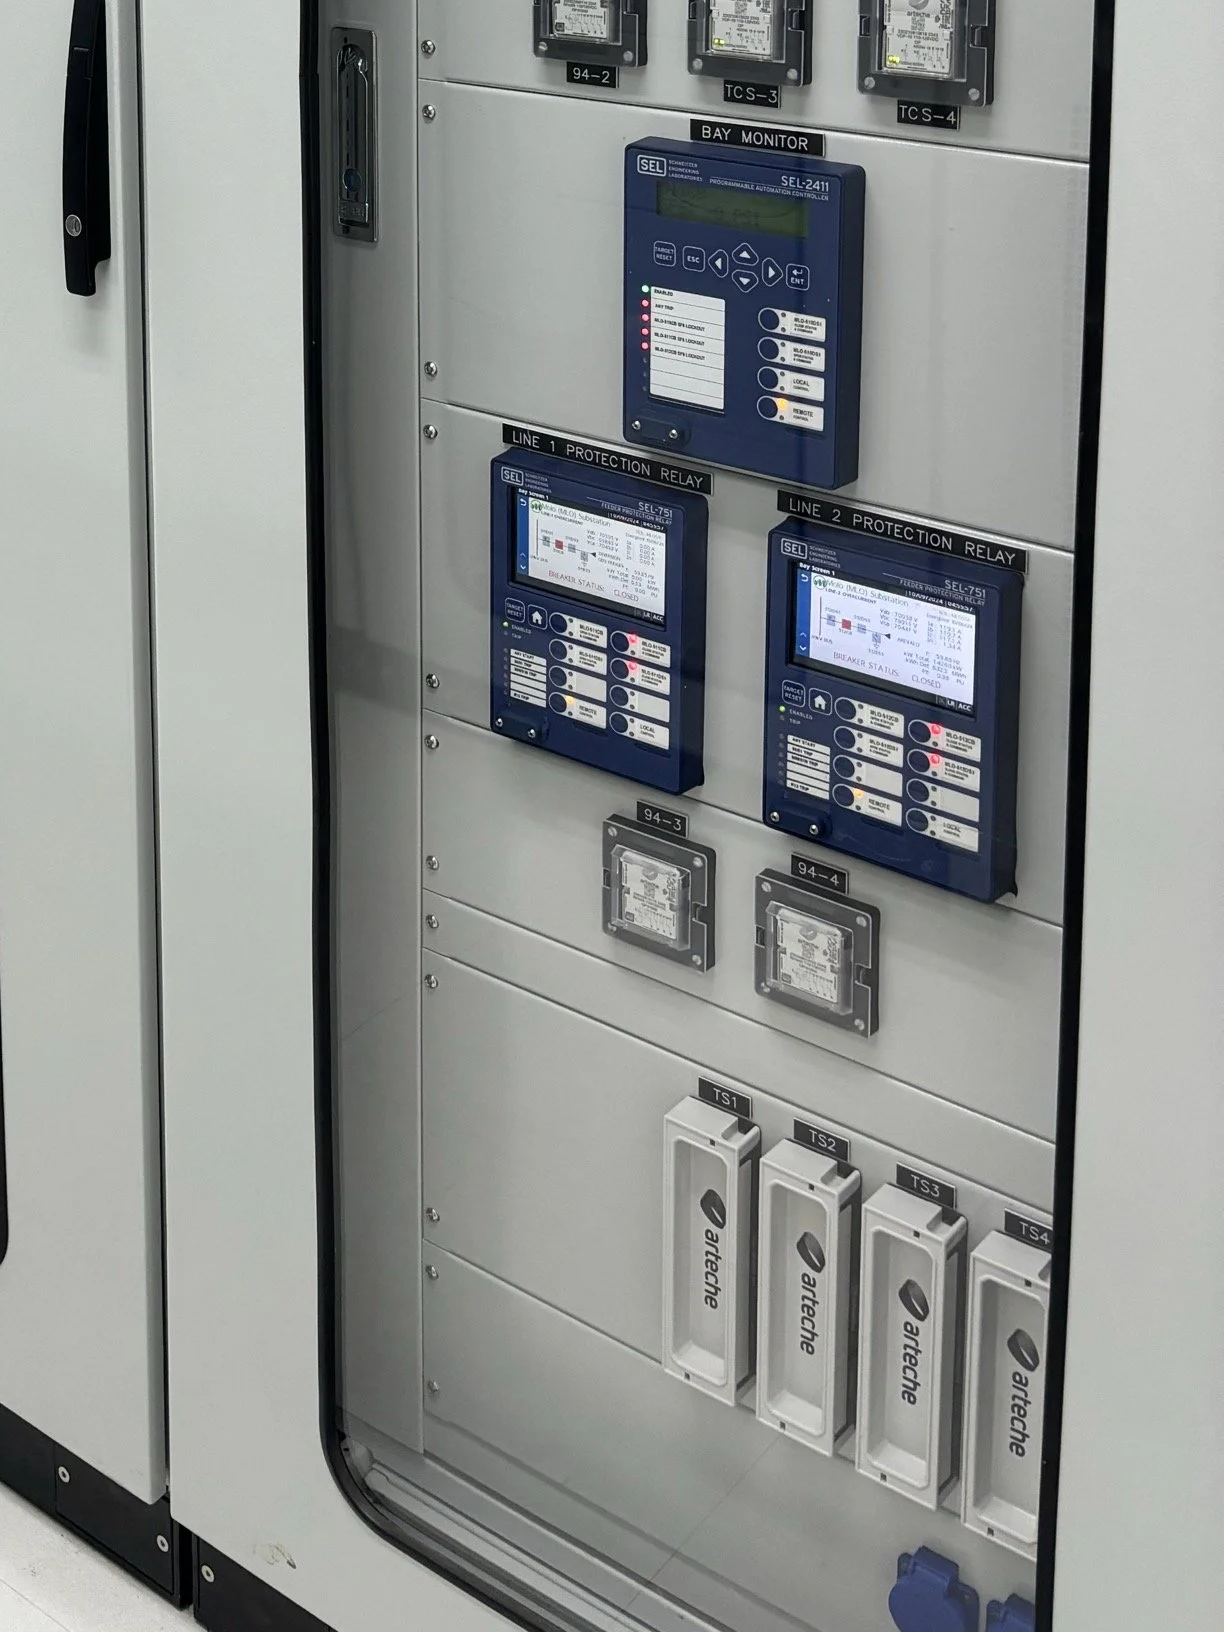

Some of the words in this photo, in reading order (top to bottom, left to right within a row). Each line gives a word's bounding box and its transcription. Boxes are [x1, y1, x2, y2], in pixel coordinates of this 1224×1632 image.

[573, 67, 610, 84] 94-2
[726, 83, 778, 104] TCS-3
[899, 105, 957, 126] TCS-4
[702, 125, 732, 142] BAY
[742, 131, 808, 151] MONITOR
[640, 159, 663, 173] SEL
[709, 178, 755, 192] PROGRAMMABLE
[755, 185, 791, 196] AUTOMATION
[791, 189, 829, 201] CONTROLLER
[781, 175, 829, 193] SEL-2411
[687, 255, 700, 263] ESC
[791, 277, 804, 286] ENT
[793, 378, 810, 387] LOCAL
[792, 408, 814, 417] REMOTE
[513, 430, 540, 448] LINE
[550, 441, 555, 452] 1
[567, 444, 650, 476] PROTECTION
[661, 468, 703, 489] RELAY
[503, 470, 521, 484] SEL
[639, 502, 673, 518] SEL-751
[789, 498, 821, 517] LINE
[832, 510, 841, 522] 2
[853, 514, 953, 552] PROTECTION
[965, 542, 1016, 566] RELAY
[783, 542, 804, 557] SEL
[870, 591, 909, 608] Substation
[945, 579, 987, 599] SEL-751
[958, 703, 971, 712] ACC
[644, 808, 682, 831] 94-3
[798, 862, 839, 887] 94-4
[713, 1087, 738, 1109] TS1
[809, 1128, 836, 1152] TS2
[911, 1175, 941, 1198] TS3
[1019, 1221, 1050, 1246] TS4
[704, 1228, 719, 1311] arteche
[800, 1272, 817, 1356] arteche
[901, 1320, 920, 1406] arteche
[1009, 1370, 1029, 1459] arteche
